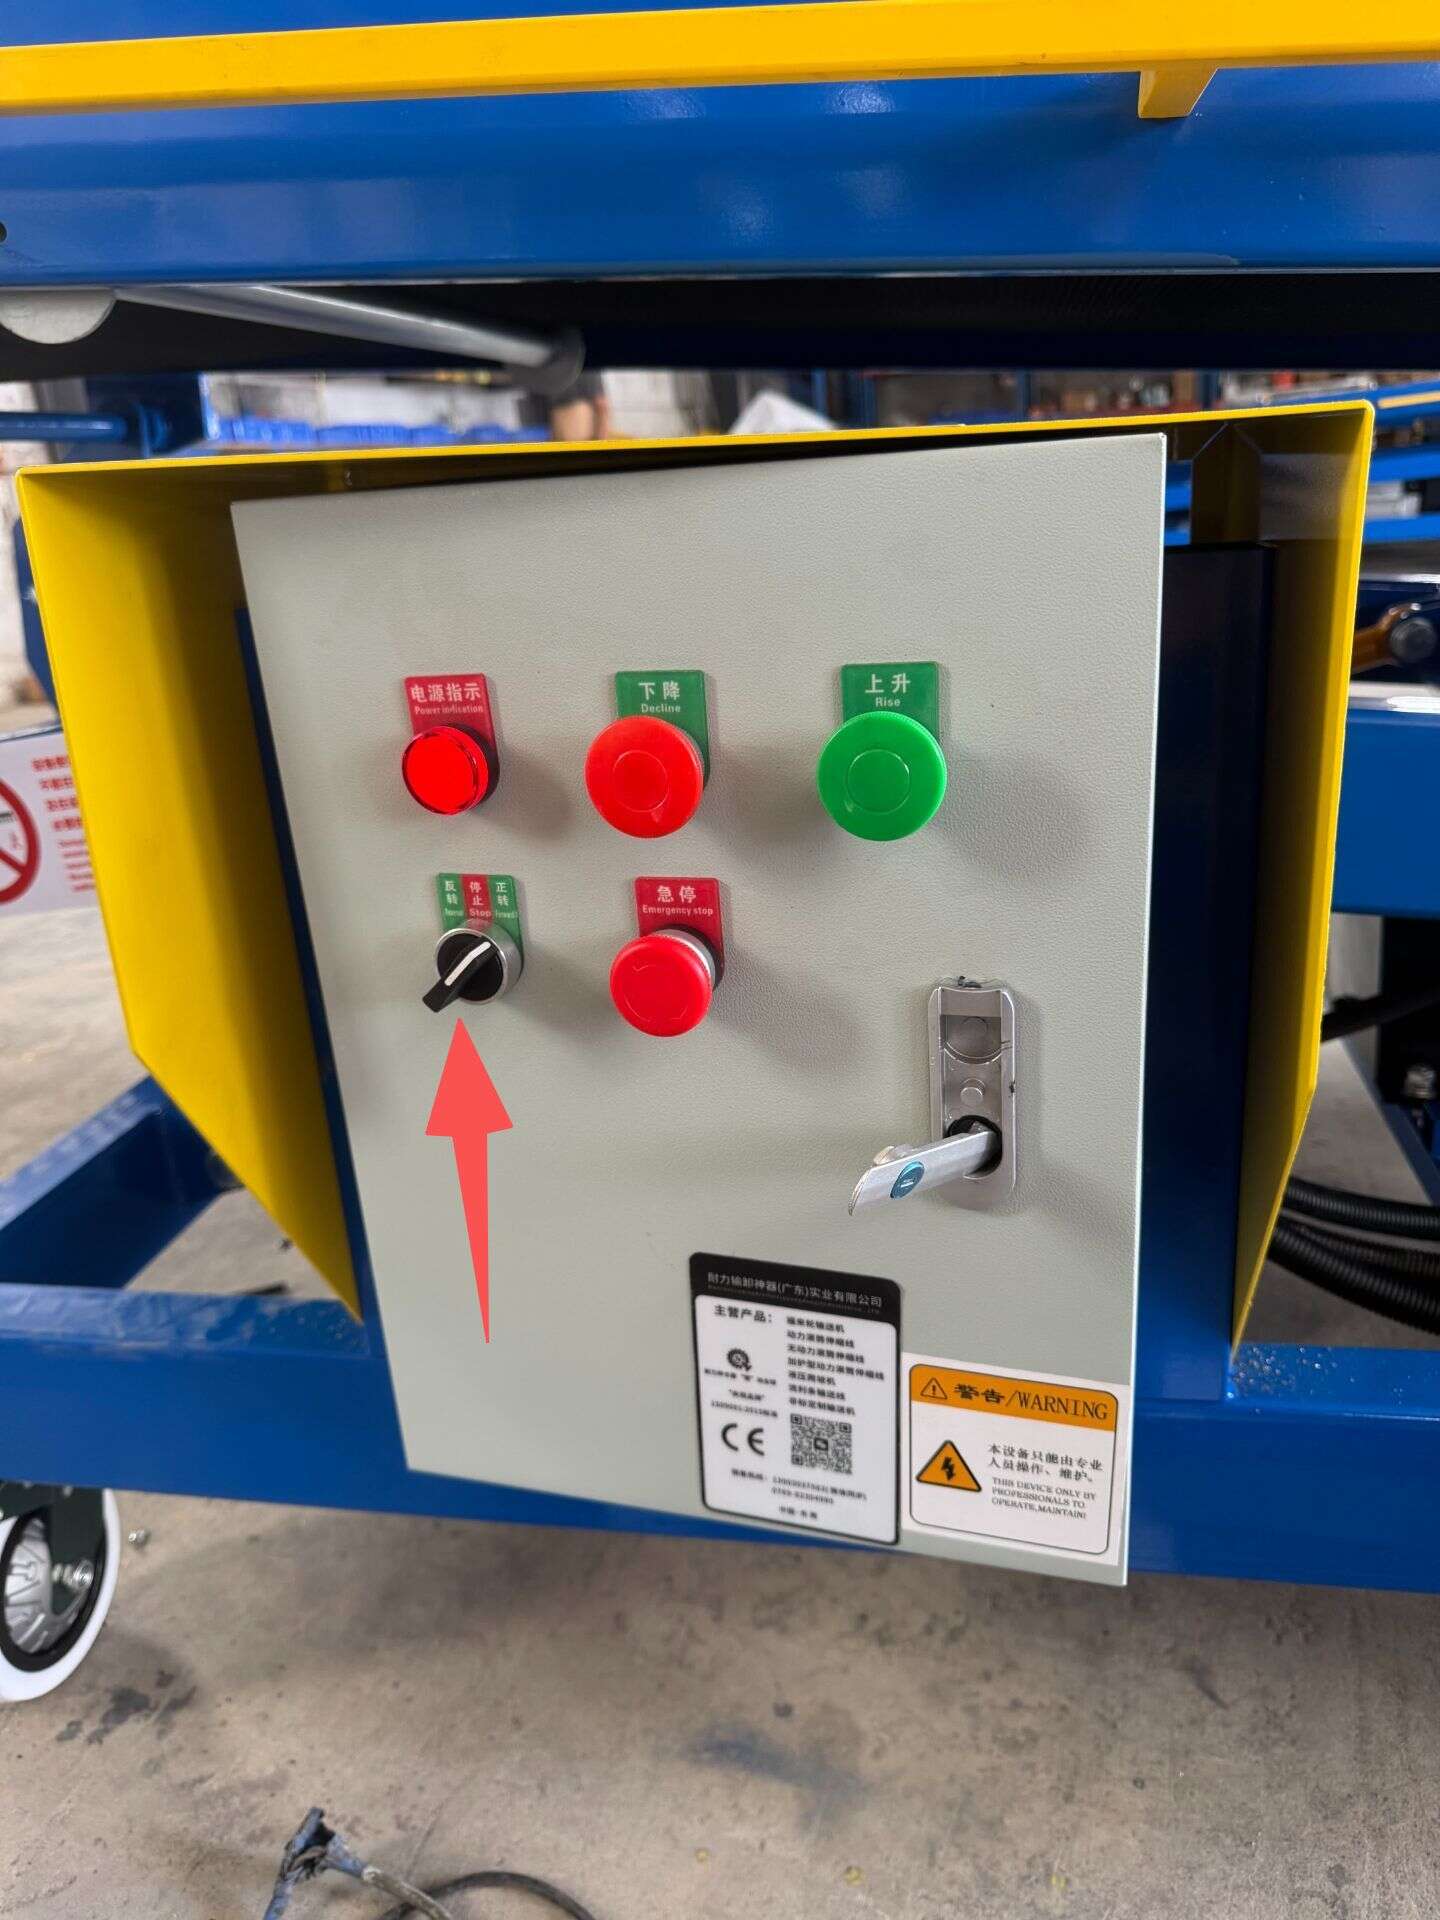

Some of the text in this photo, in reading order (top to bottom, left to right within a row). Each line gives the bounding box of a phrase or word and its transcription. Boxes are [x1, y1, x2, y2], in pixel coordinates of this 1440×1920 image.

[410, 682, 481, 703] 电源指示
[638, 681, 681, 701] 下降
[864, 672, 911, 694] 上升
[414, 706, 441, 715] Power
[640, 703, 681, 714] Decline
[875, 697, 901, 708] Rise
[469, 881, 485, 906] 停止
[657, 885, 697, 904] 急停
[468, 908, 492, 918] Stop
[642, 904, 714, 918] Emergency stop
[721, 1423, 765, 1457] CE
[992, 1476, 1015, 1487] THIS
[1016, 1480, 1053, 1493] DEVICE
[1055, 1487, 1081, 1498] ONLY
[1072, 1500, 1086, 1509] TO
